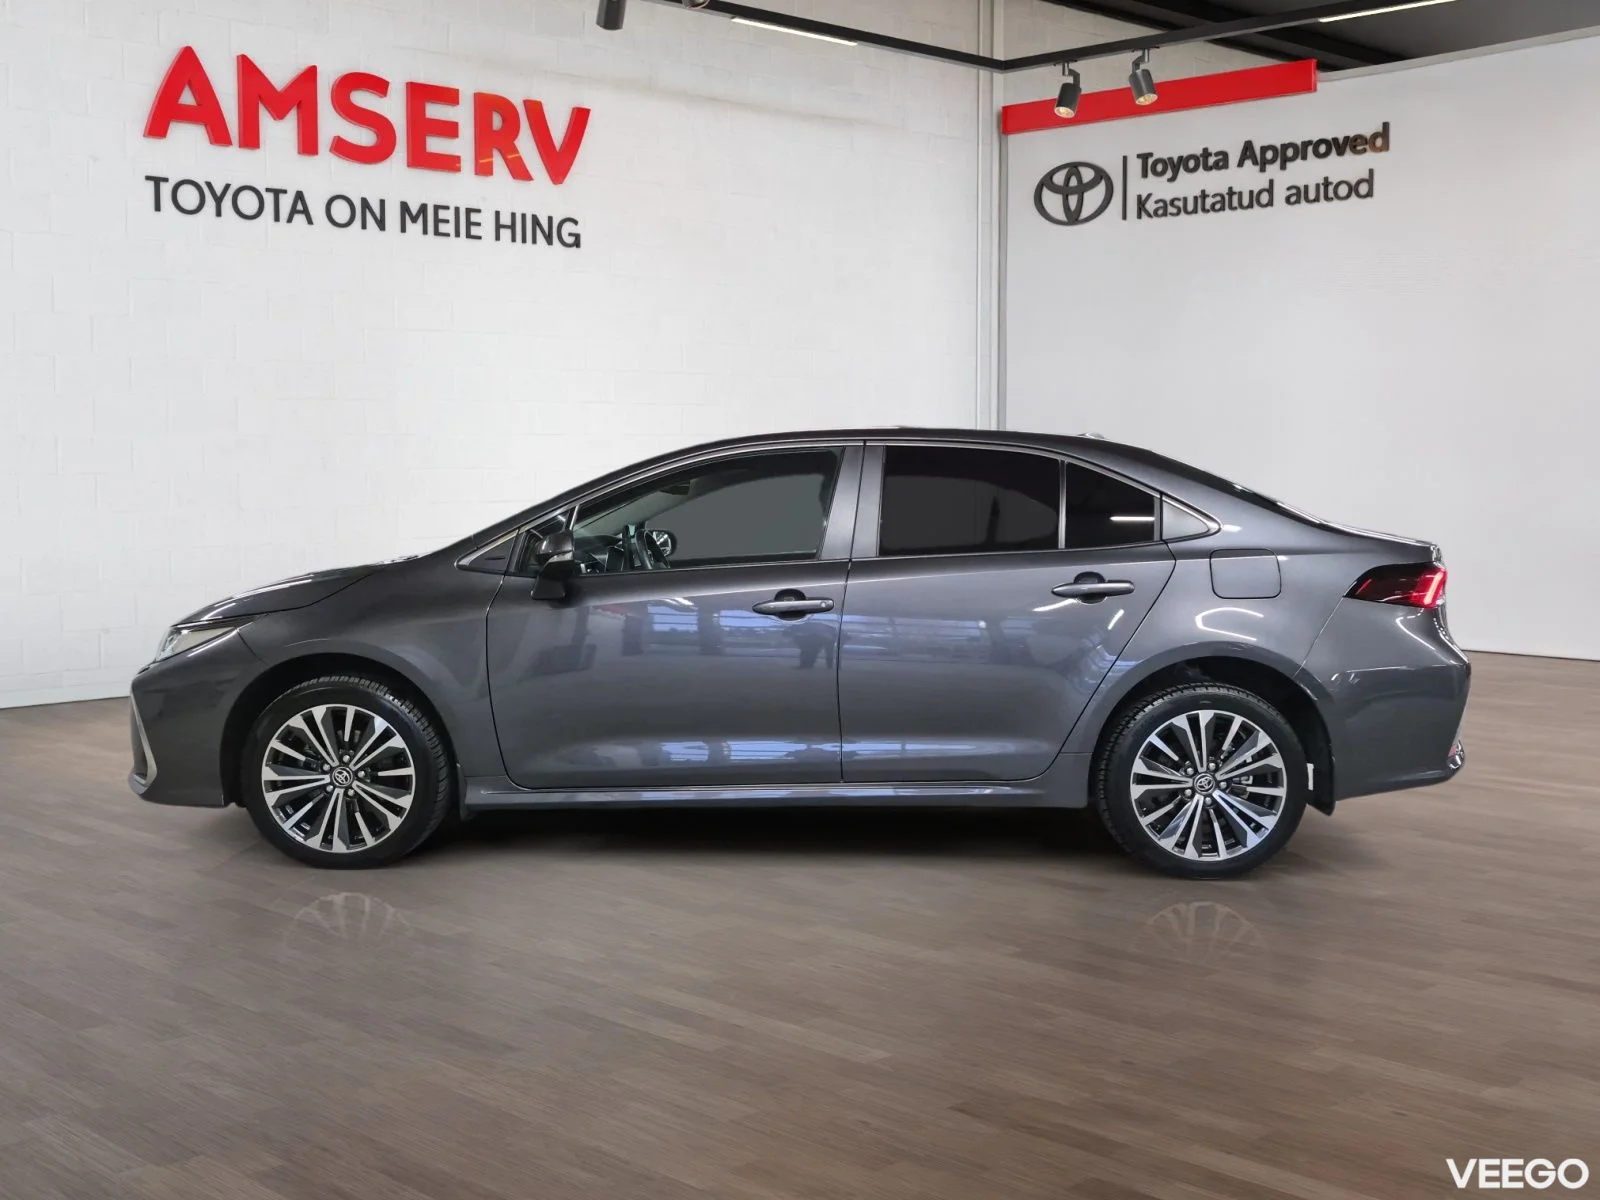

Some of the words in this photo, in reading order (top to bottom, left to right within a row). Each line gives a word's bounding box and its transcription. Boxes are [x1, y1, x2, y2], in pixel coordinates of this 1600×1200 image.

[143, 45, 591, 185] AMSERV
[1137, 147, 1230, 183] Toyota
[1237, 121, 1391, 174] Approved
[144, 175, 314, 226] TOYOTA
[324, 194, 386, 232] ON
[399, 200, 483, 240] MEIE
[494, 210, 582, 249] HING
[1136, 178, 1275, 220] Kasutatud
[1284, 168, 1375, 207] autod
